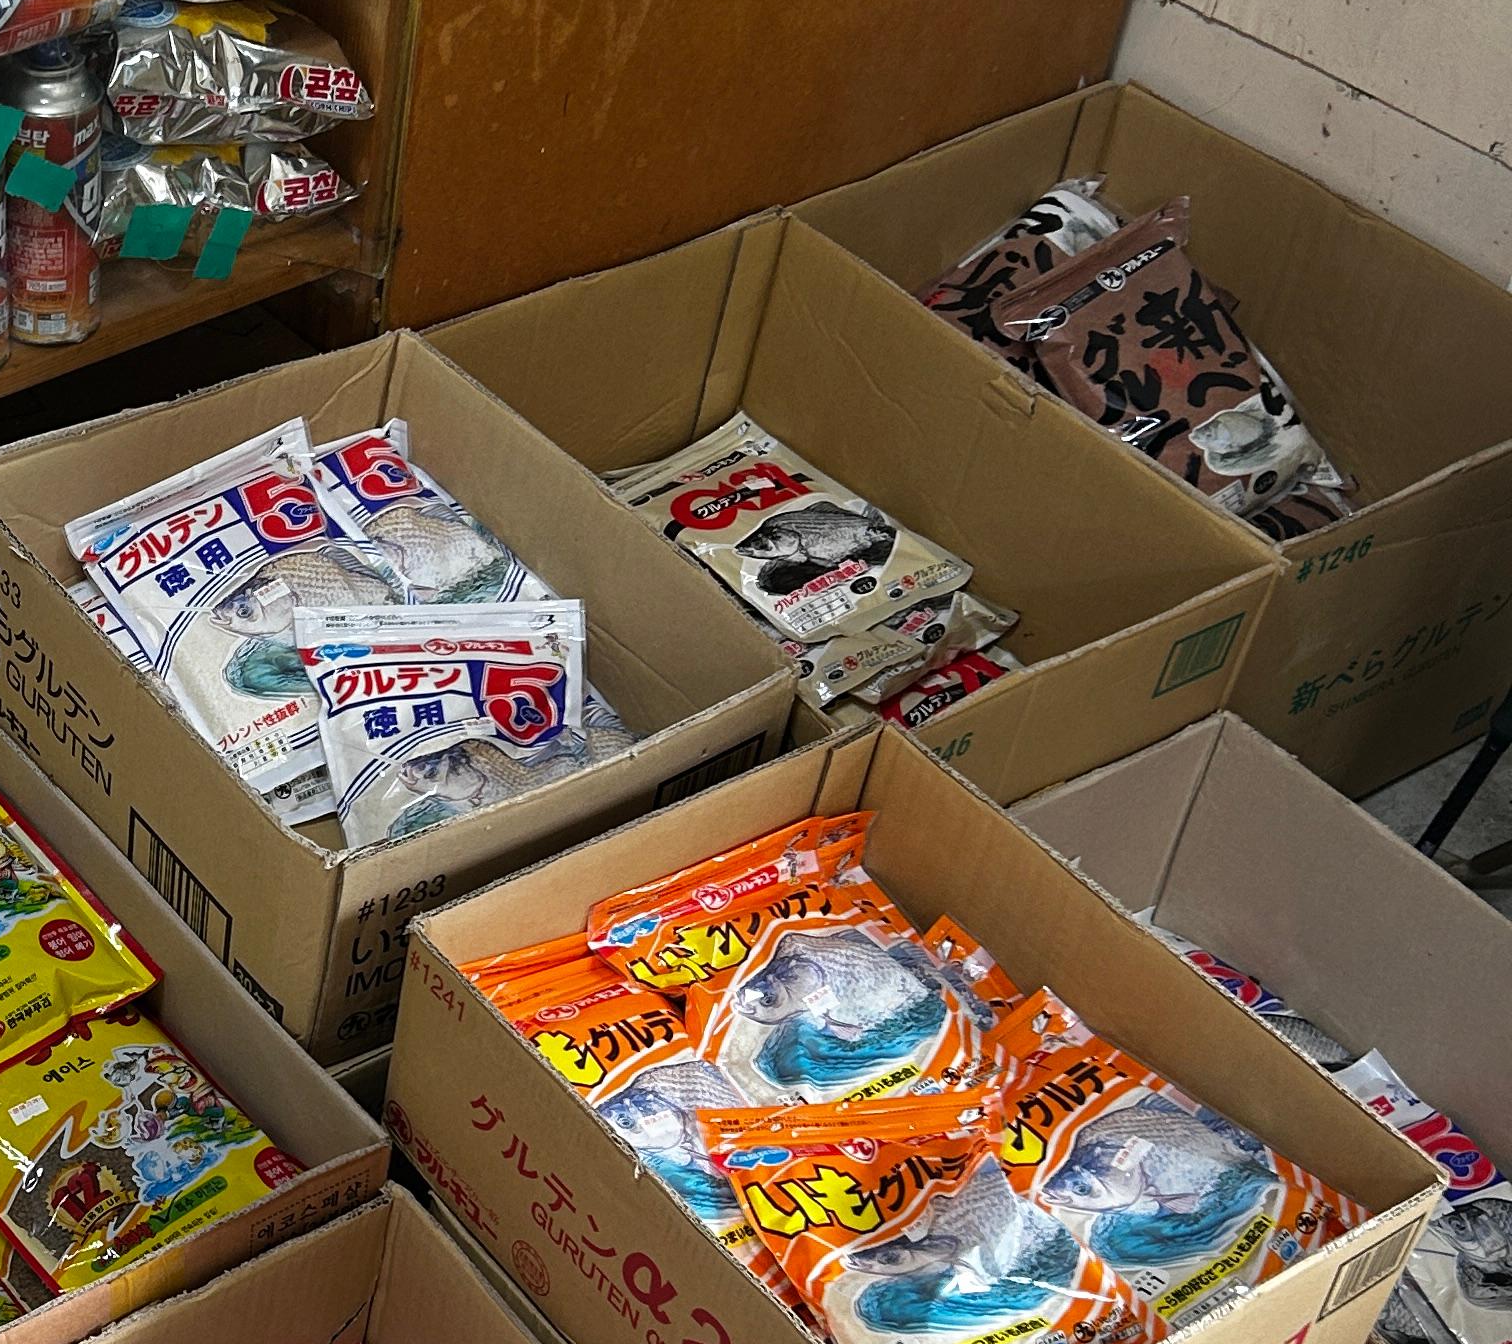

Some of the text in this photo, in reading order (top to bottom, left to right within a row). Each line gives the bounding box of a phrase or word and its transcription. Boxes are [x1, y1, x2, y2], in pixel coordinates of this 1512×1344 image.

[695, 491, 742, 519] グルテン
[113, 500, 224, 580] グルテン
[159, 536, 235, 597] 徳用
[1294, 533, 1377, 586] #1246
[329, 662, 461, 708] グルテン
[4, 661, 115, 798] GURUTEN
[363, 701, 445, 741] 徳用
[357, 873, 448, 924] #1233
[409, 949, 467, 1024] #1241
[41, 1054, 95, 1085] 에이스
[469, 1091, 618, 1260] グルテン
[529, 1199, 641, 1332] GURUTEN
